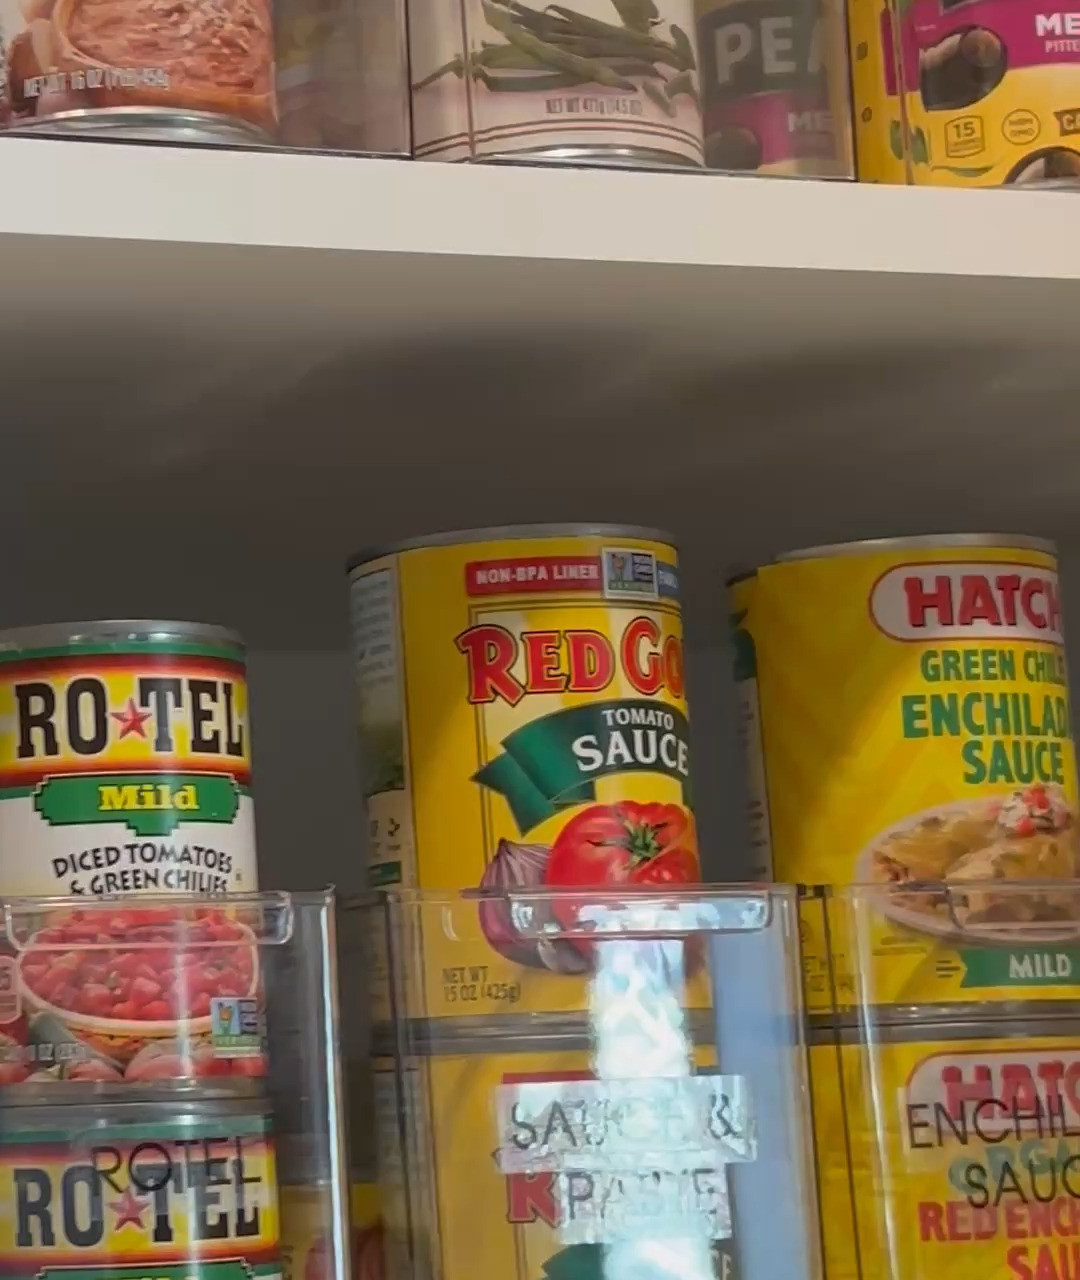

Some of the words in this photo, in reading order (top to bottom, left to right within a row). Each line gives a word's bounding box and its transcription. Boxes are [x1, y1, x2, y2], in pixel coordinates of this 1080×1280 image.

[715, 17, 825, 83] PE
[953, 121, 975, 139] 15
[454, 623, 616, 708] RED
[920, 649, 1017, 683] GREEN
[602, 709, 675, 732] TOMATO
[571, 730, 689, 777] SAUCE
[961, 740, 1066, 785] SAUCE
[97, 783, 200, 812] Mild
[51, 846, 120, 880] DICED
[125, 841, 234, 875] TOMATOES
[88, 868, 159, 896] GREEN
[443, 966, 467, 983] NET
[471, 965, 489, 982] WT
[1008, 953, 1073, 979] MILD
[90, 1135, 262, 1194] ROTEL
